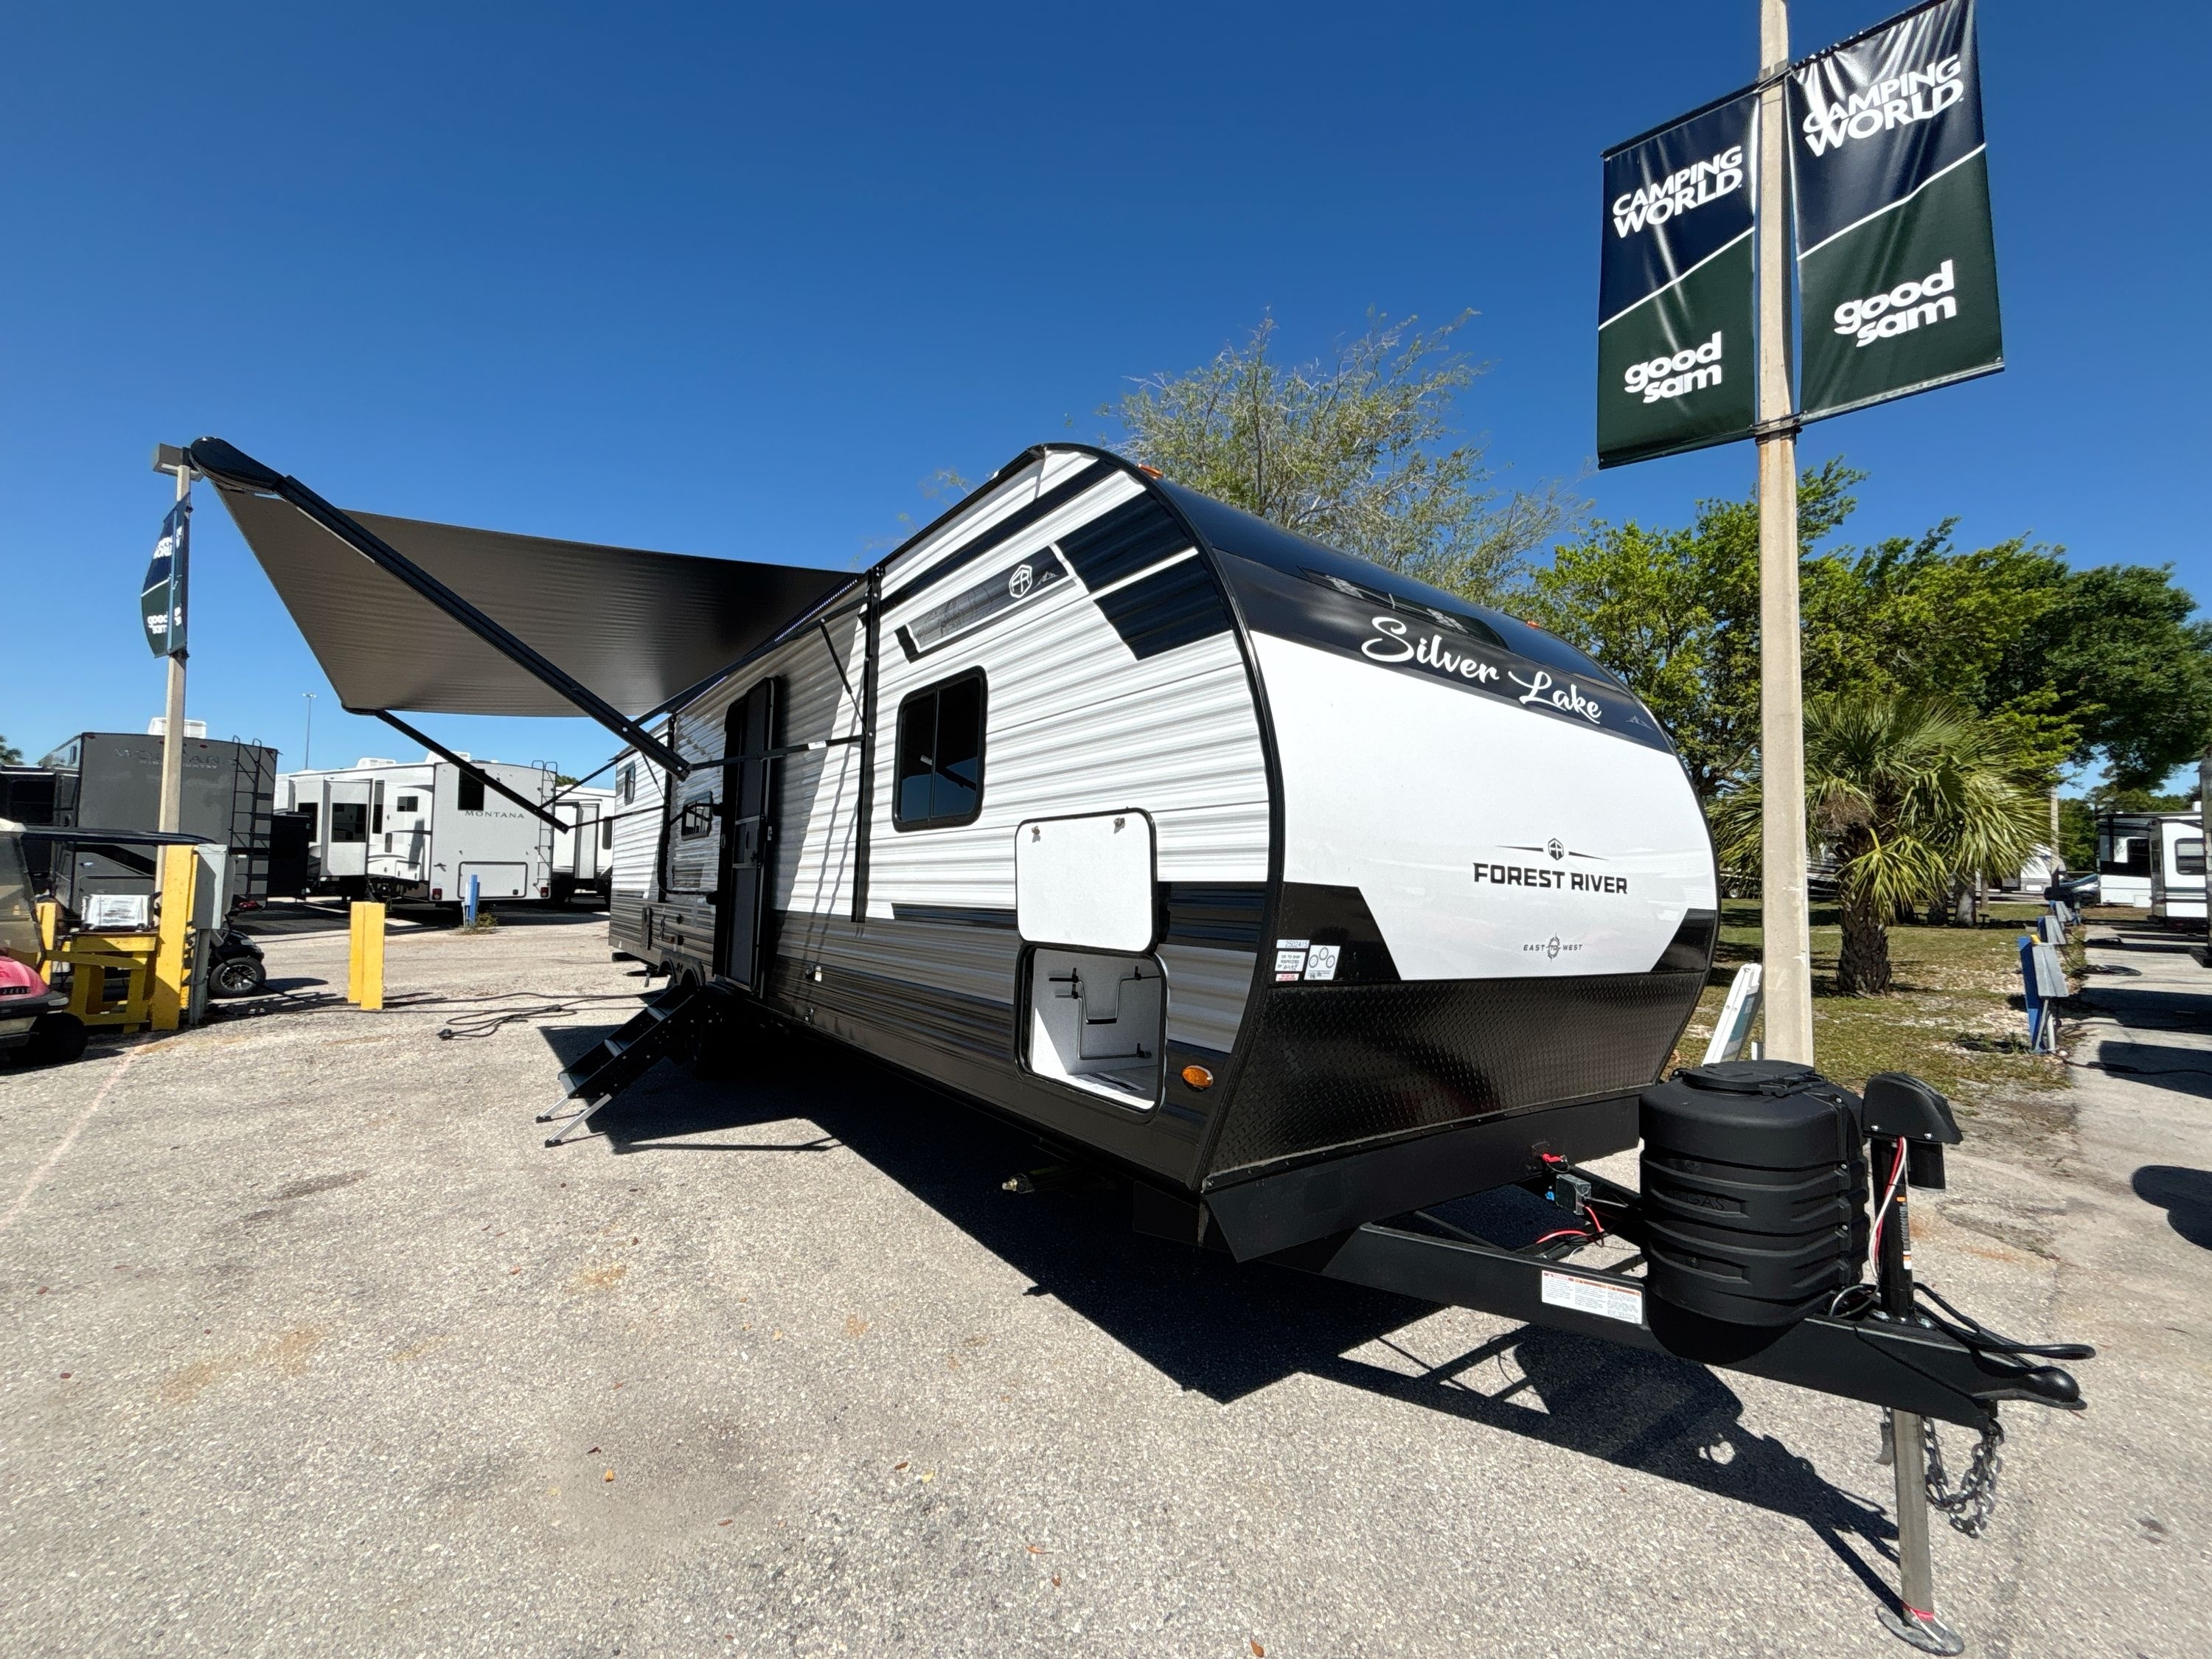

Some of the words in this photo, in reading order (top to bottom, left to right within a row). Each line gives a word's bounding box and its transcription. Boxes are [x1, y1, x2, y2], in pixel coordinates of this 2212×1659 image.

[1802, 53, 1962, 134] CAMPING
[1804, 77, 1960, 157] WORLD
[1613, 145, 1743, 217] CAMPING
[1613, 168, 1742, 238] WORLD
[1834, 260, 1955, 335] good
[1856, 296, 1958, 347] sam
[1624, 331, 1722, 393] good
[1643, 364, 1722, 403] sam
[1362, 616, 1500, 684] Silver
[1508, 671, 1602, 724] Lake
[465, 810, 524, 818] MONTANA
[1472, 862, 1565, 889] FOREST
[1570, 872, 1628, 894] RIVER
